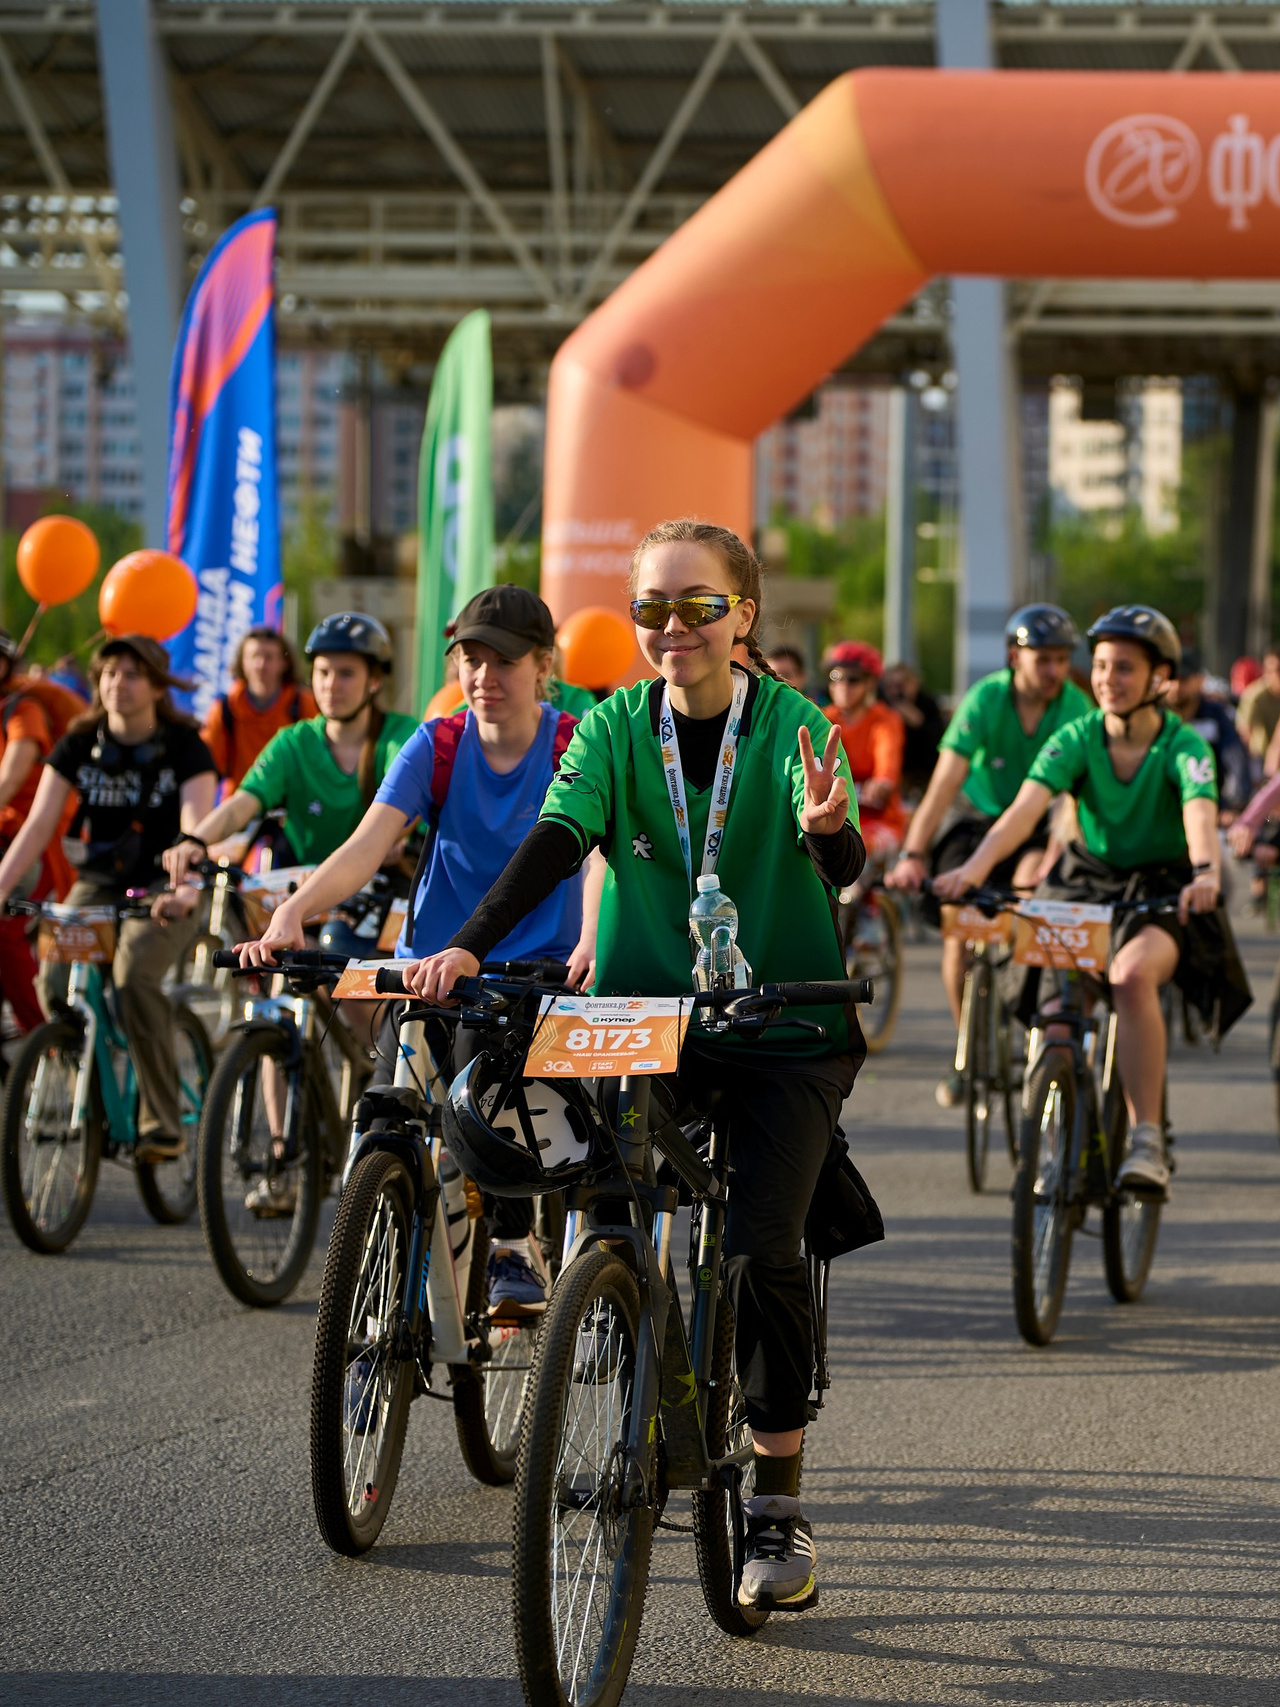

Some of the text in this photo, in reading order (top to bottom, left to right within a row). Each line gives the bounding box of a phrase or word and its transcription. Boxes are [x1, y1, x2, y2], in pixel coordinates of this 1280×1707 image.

[666, 768, 681, 808] фонтанка.ру
[716, 765, 733, 806] фонтанка.ру
[584, 1001, 628, 1010] фонтанка.ру
[565, 1028, 653, 1050] 8173
